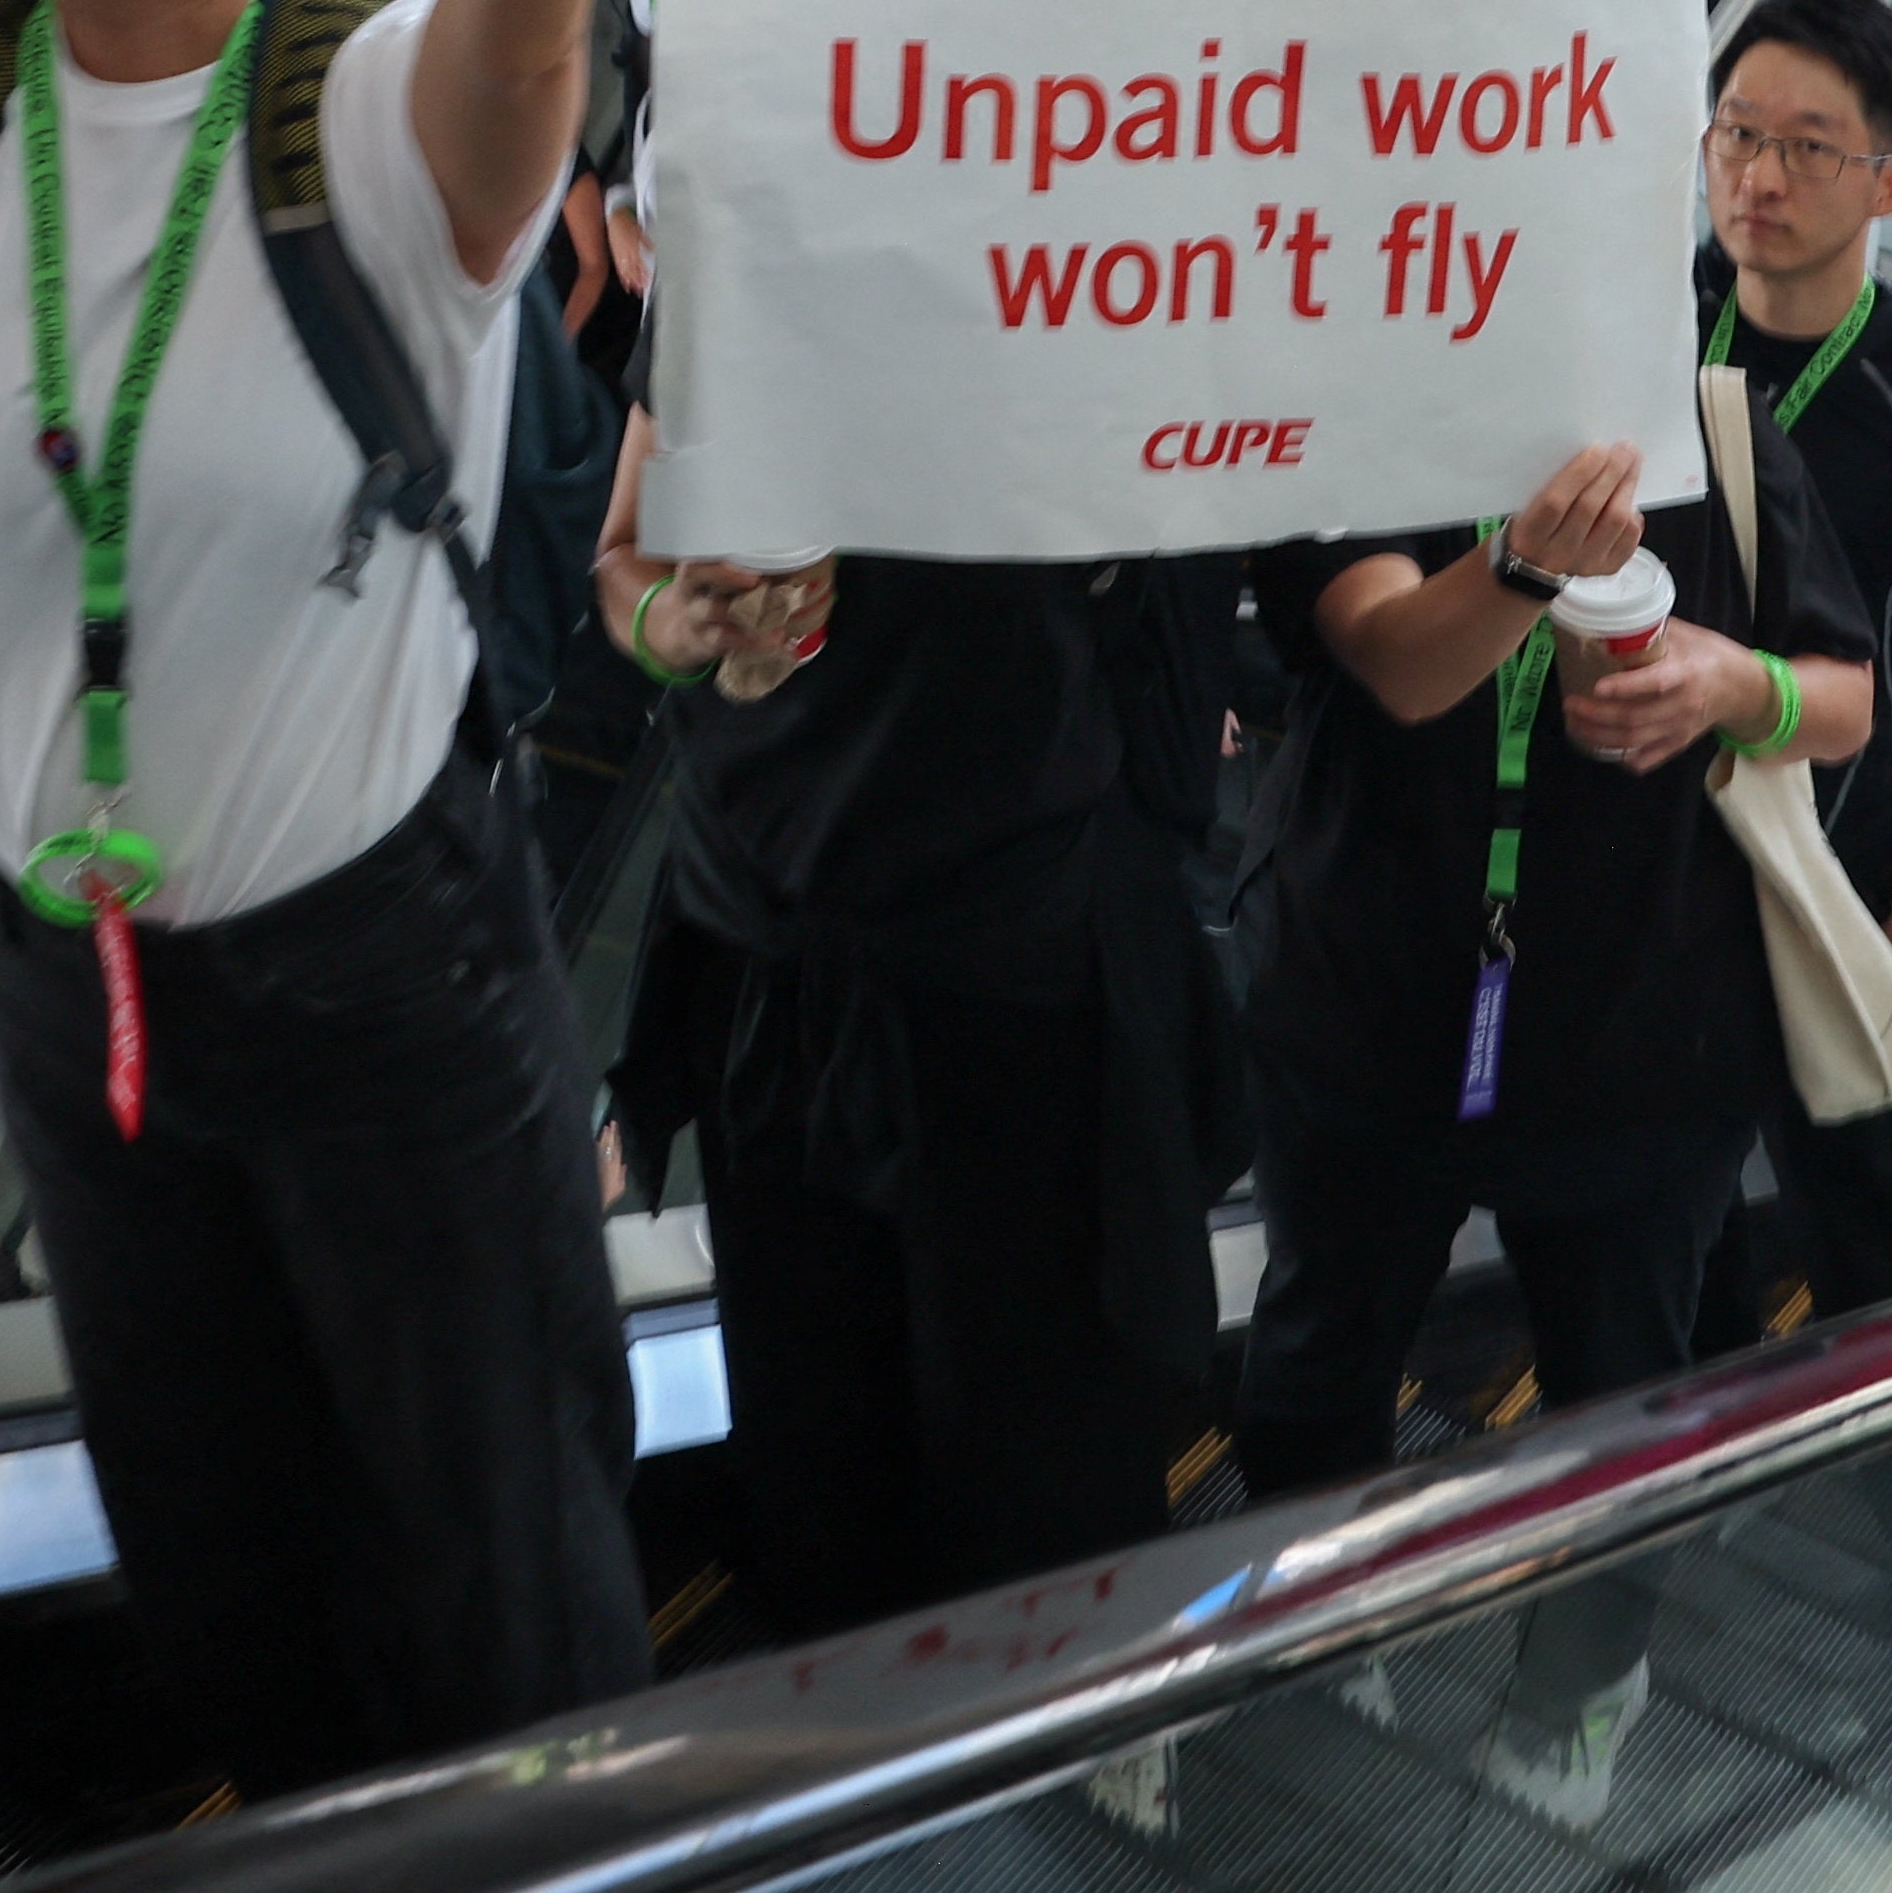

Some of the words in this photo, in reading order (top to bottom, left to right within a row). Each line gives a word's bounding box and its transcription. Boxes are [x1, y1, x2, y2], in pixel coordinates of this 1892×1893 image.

[826, 35, 1308, 194] Unpaid
[1357, 28, 1618, 158] work
[985, 201, 1332, 330] won't
[1376, 199, 1520, 344] fly
[1138, 416, 1315, 474] CUPE
